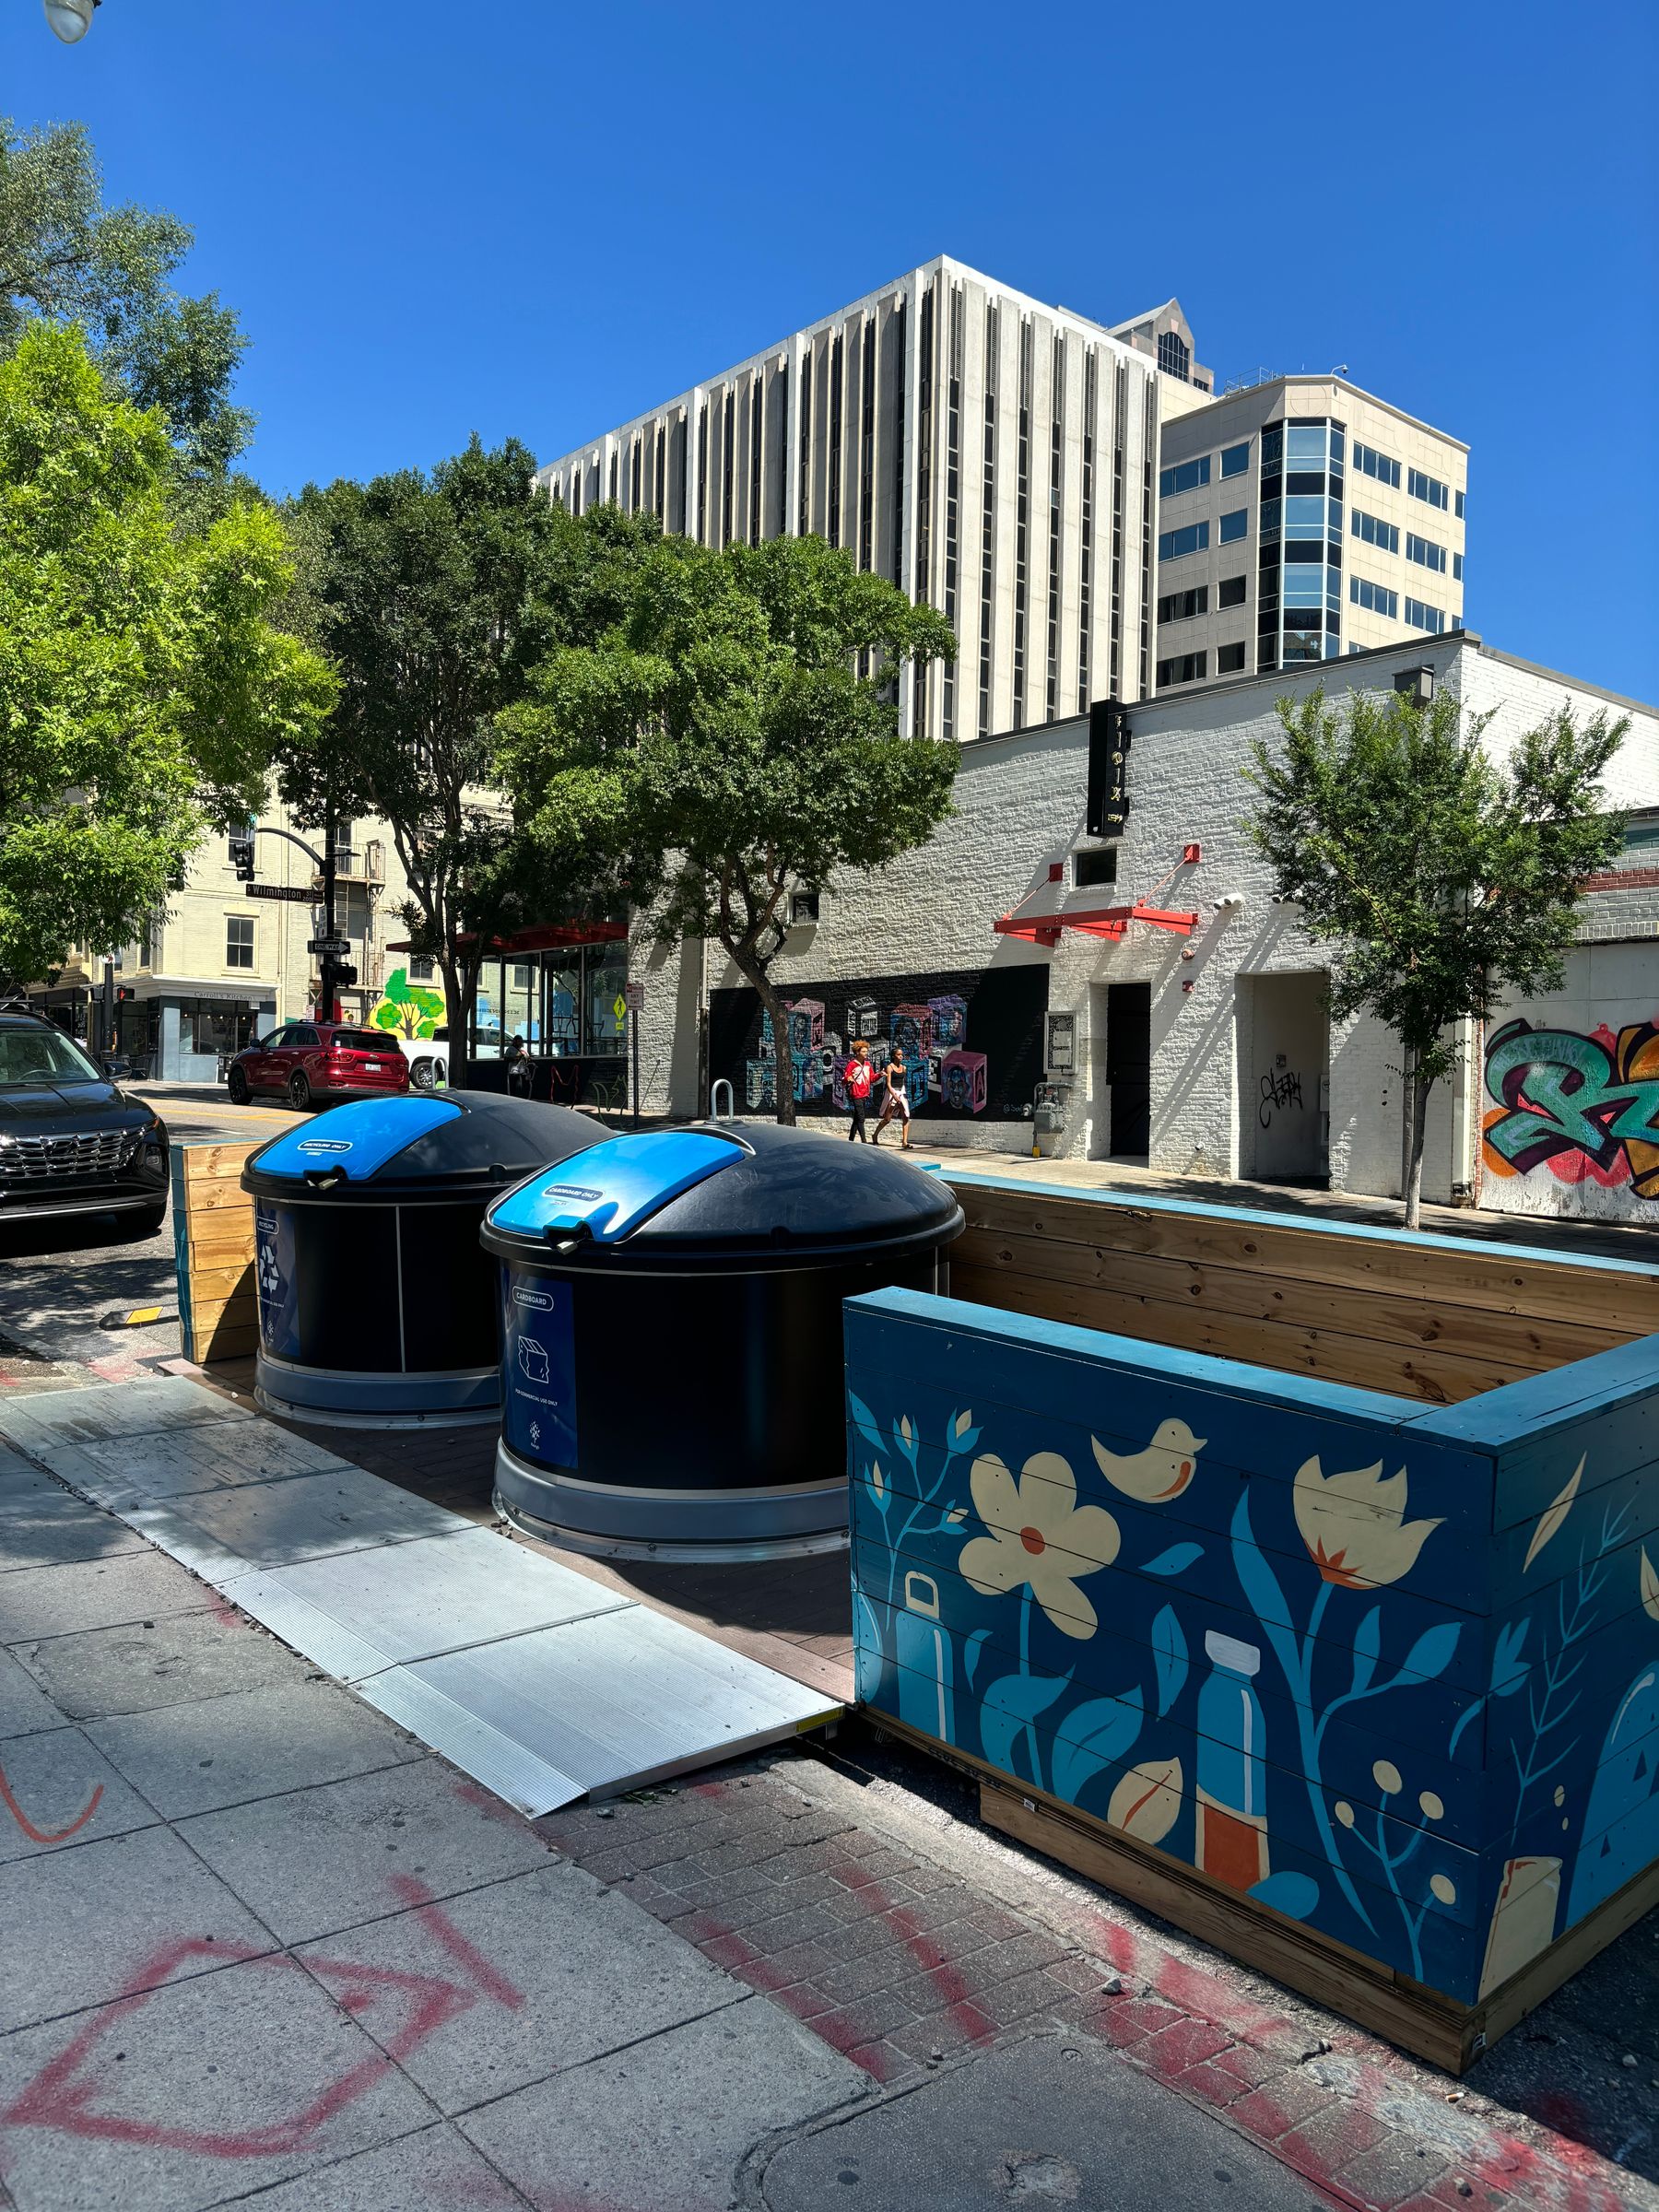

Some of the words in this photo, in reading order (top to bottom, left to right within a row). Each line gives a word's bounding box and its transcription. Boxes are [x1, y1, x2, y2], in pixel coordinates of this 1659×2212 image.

[253, 885, 301, 900] Wilmington
[848, 1012, 856, 1034] LIVES
[516, 1292, 547, 1305] CARDBOARD
[521, 1390, 540, 1402] COMMERCIAL
